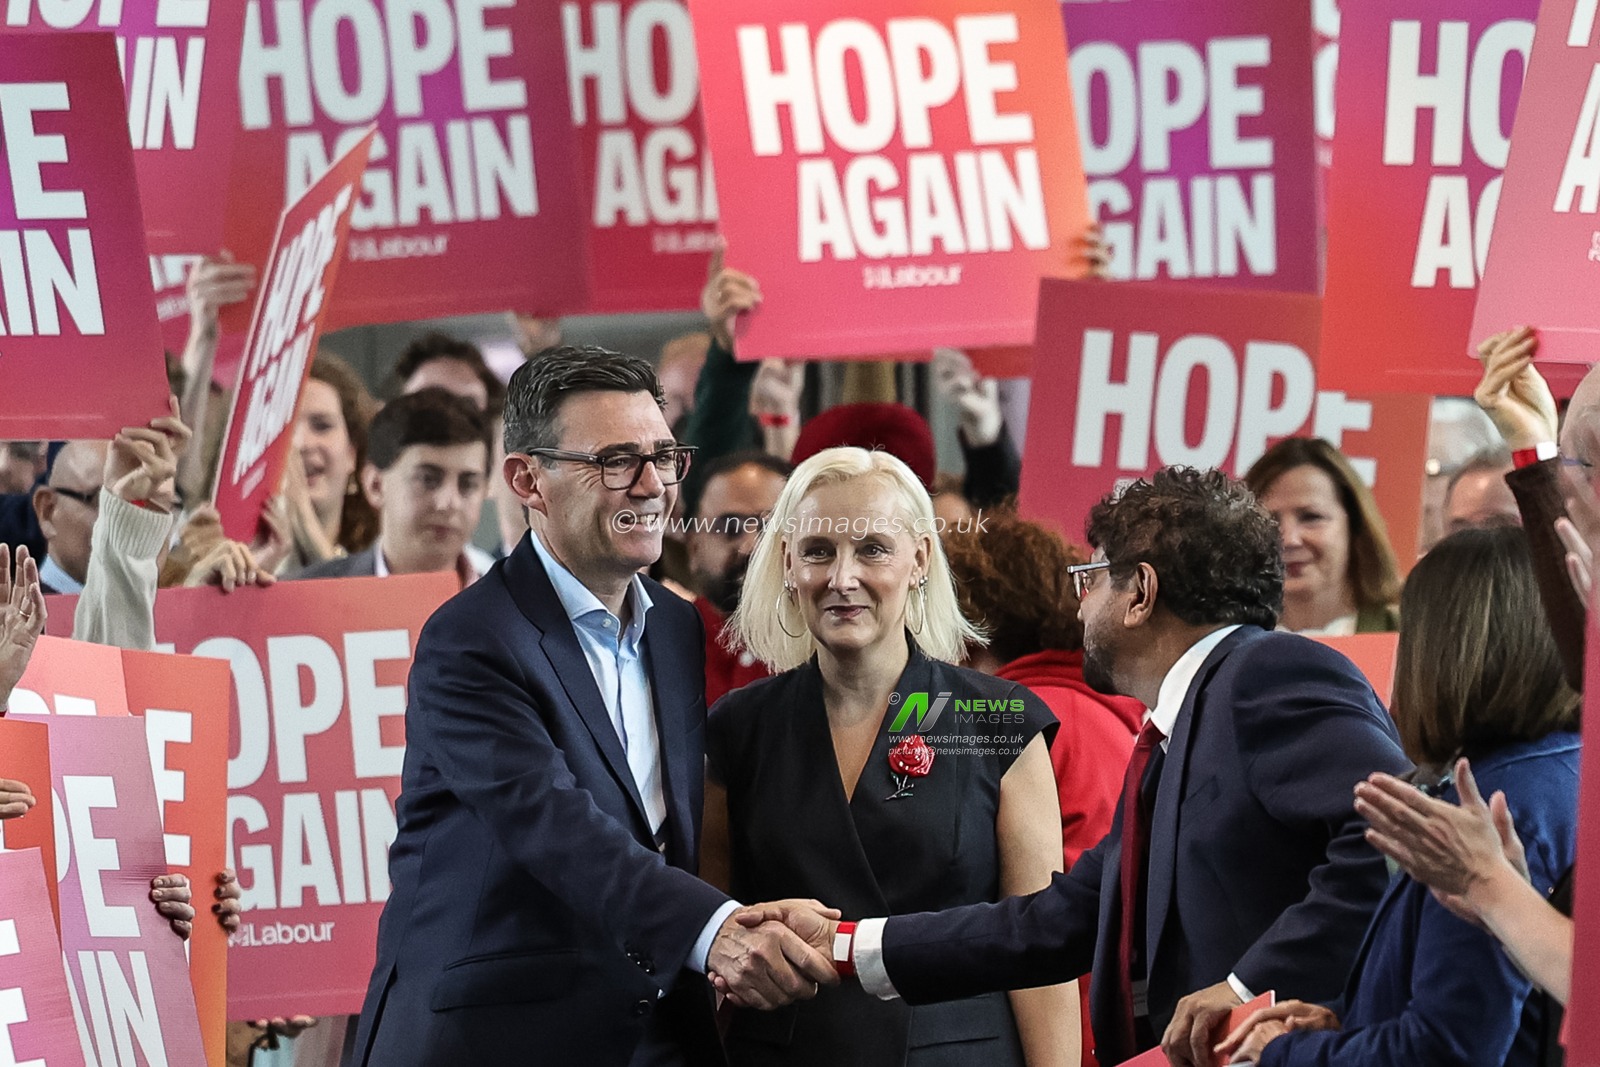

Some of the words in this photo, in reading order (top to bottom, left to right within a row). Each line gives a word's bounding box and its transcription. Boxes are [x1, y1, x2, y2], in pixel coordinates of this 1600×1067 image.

[239, 0, 527, 130] HOPE
[736, 12, 1036, 157] HOPE
[797, 146, 1051, 263] AGAIN
[155, 629, 411, 790] OPE
[249, 921, 335, 946] Labour
